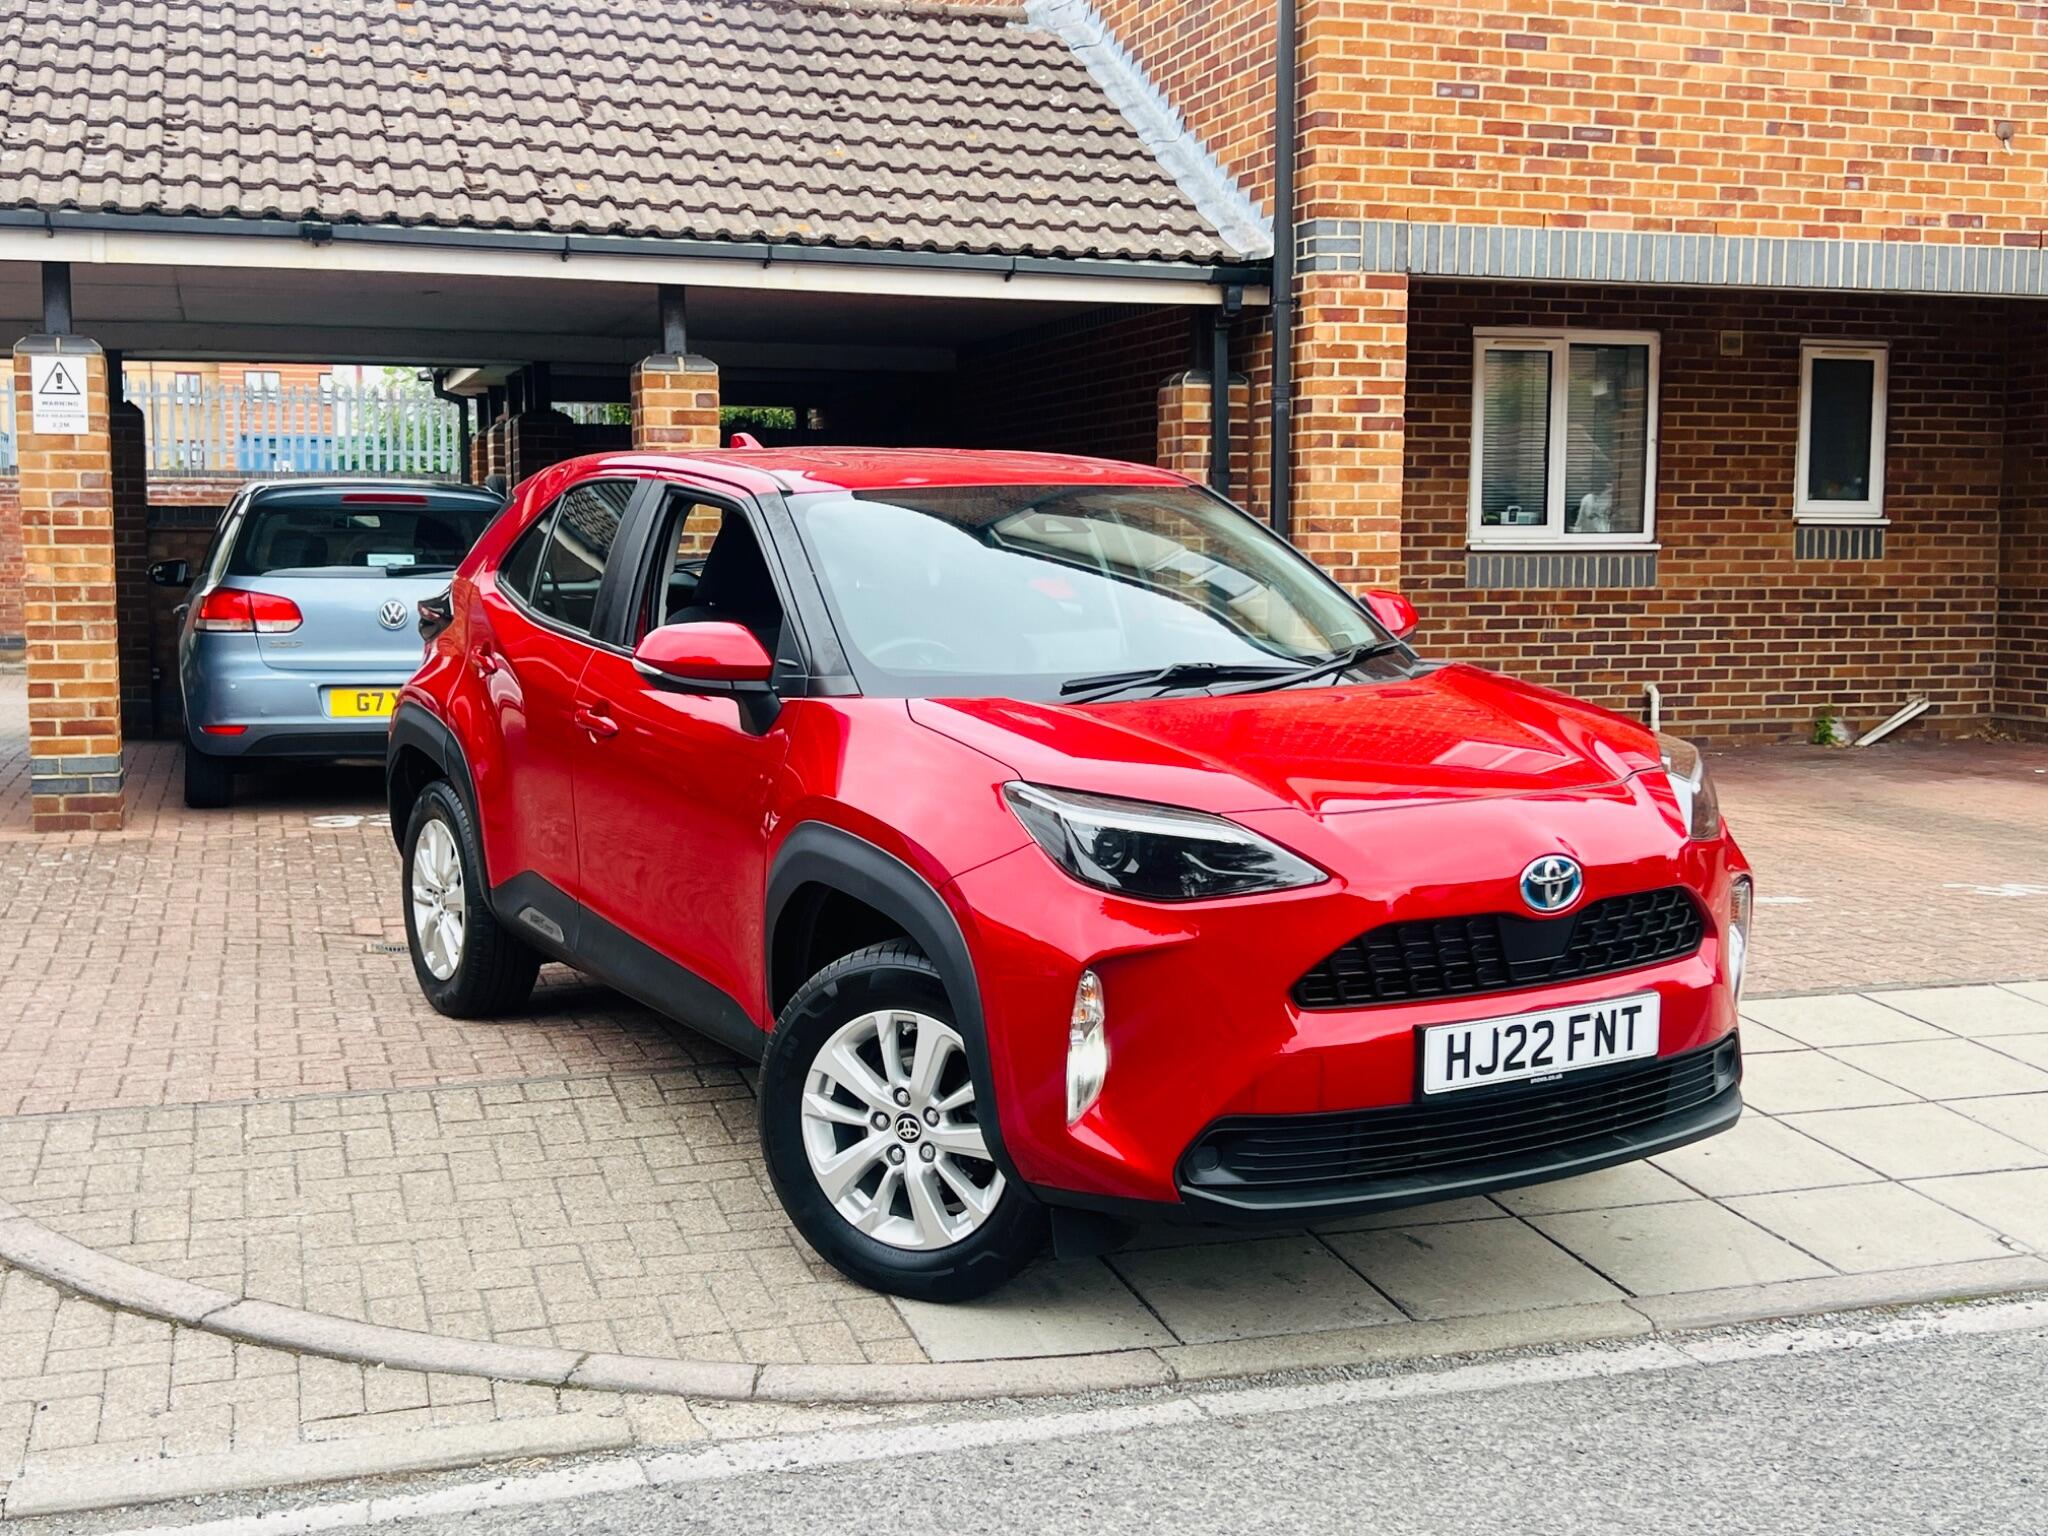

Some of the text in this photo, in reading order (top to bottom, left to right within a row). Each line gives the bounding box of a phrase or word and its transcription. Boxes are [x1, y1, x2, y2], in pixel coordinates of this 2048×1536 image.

[357, 693, 384, 711] G7
[1446, 1005, 1642, 1081] HJ22 FNT
